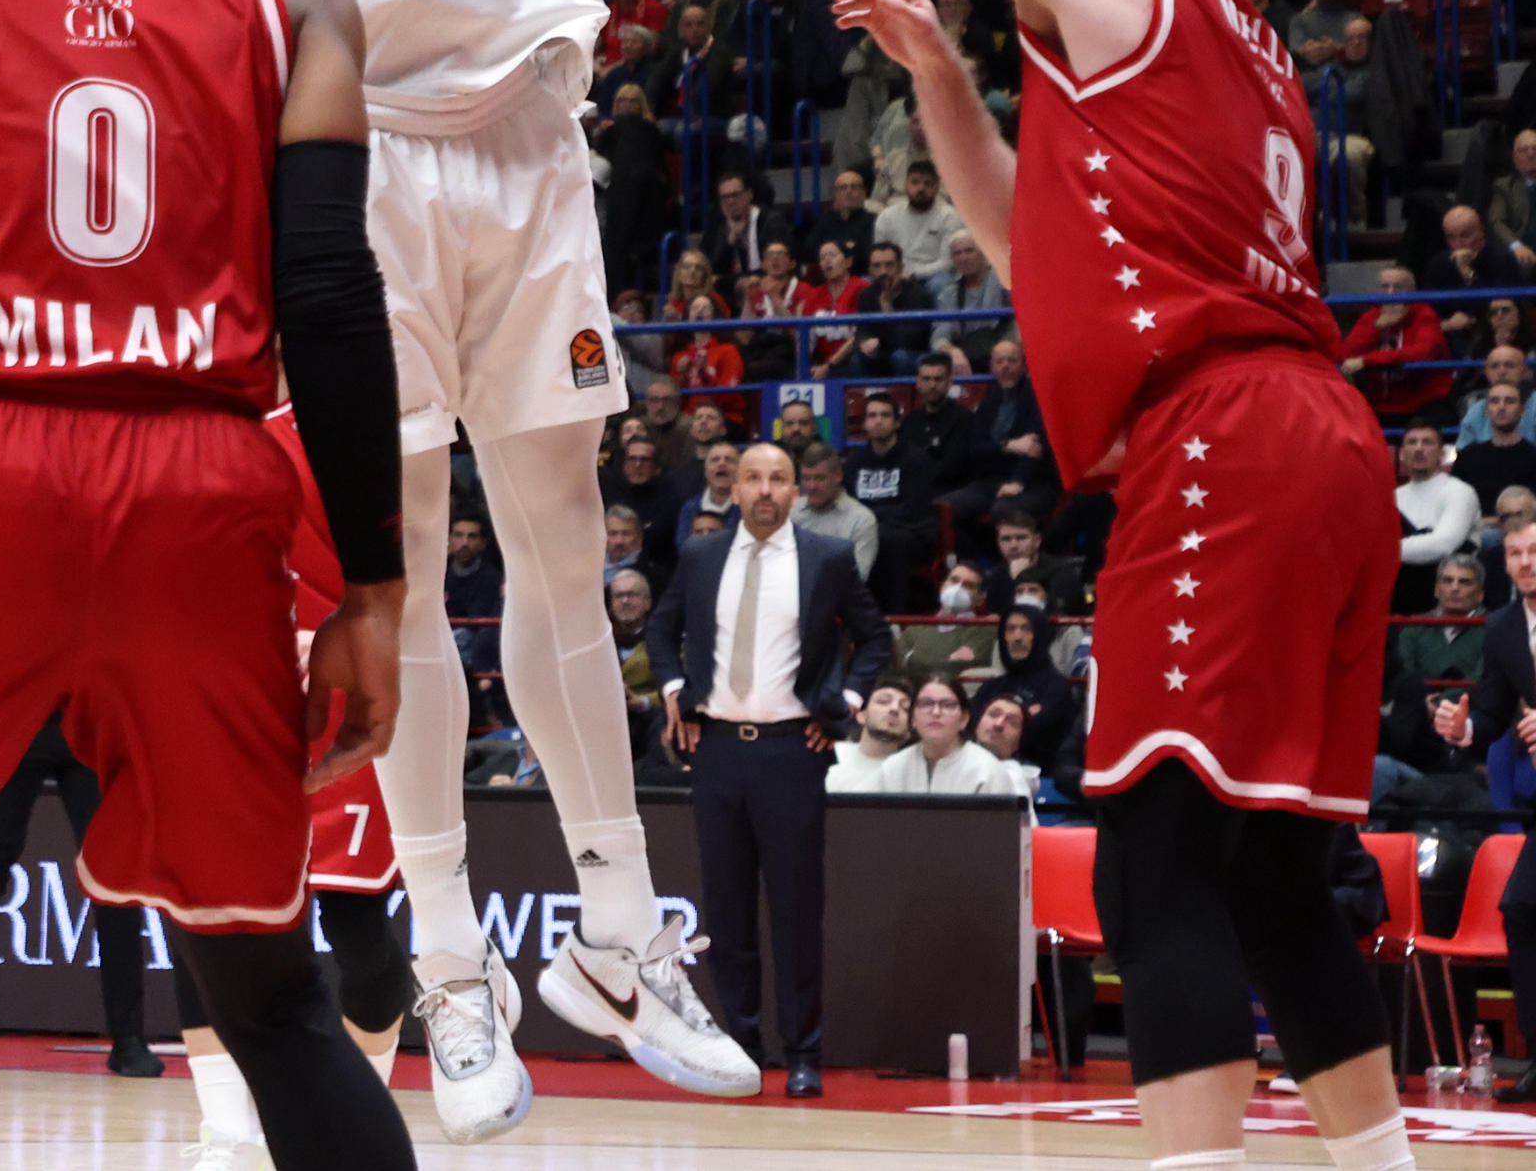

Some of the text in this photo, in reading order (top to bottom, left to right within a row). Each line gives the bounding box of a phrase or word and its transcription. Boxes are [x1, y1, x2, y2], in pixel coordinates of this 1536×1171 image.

[48, 77, 155, 268] 0
[1263, 126, 1311, 272] 9
[343, 803, 370, 857] 7
